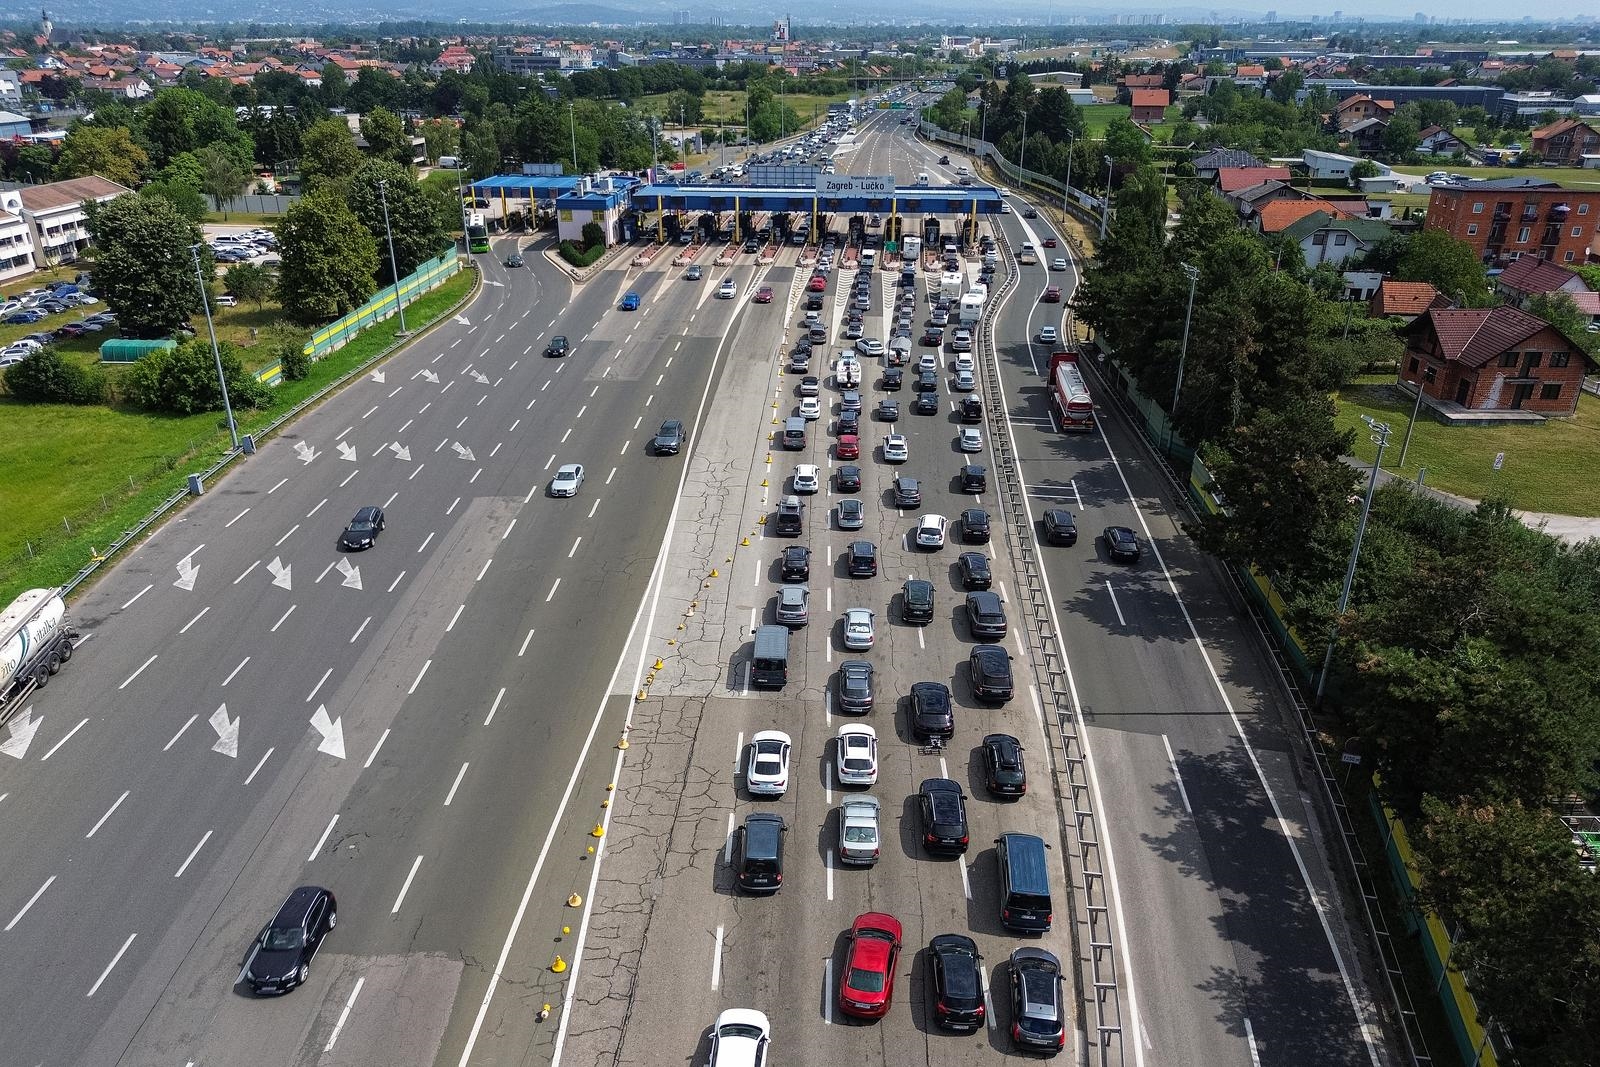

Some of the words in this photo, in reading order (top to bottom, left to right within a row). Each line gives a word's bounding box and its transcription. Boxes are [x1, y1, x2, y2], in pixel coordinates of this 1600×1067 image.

[827, 181, 853, 191] Zagreb
[861, 181, 884, 190] Lučko
[33, 617, 57, 643] vitalka
